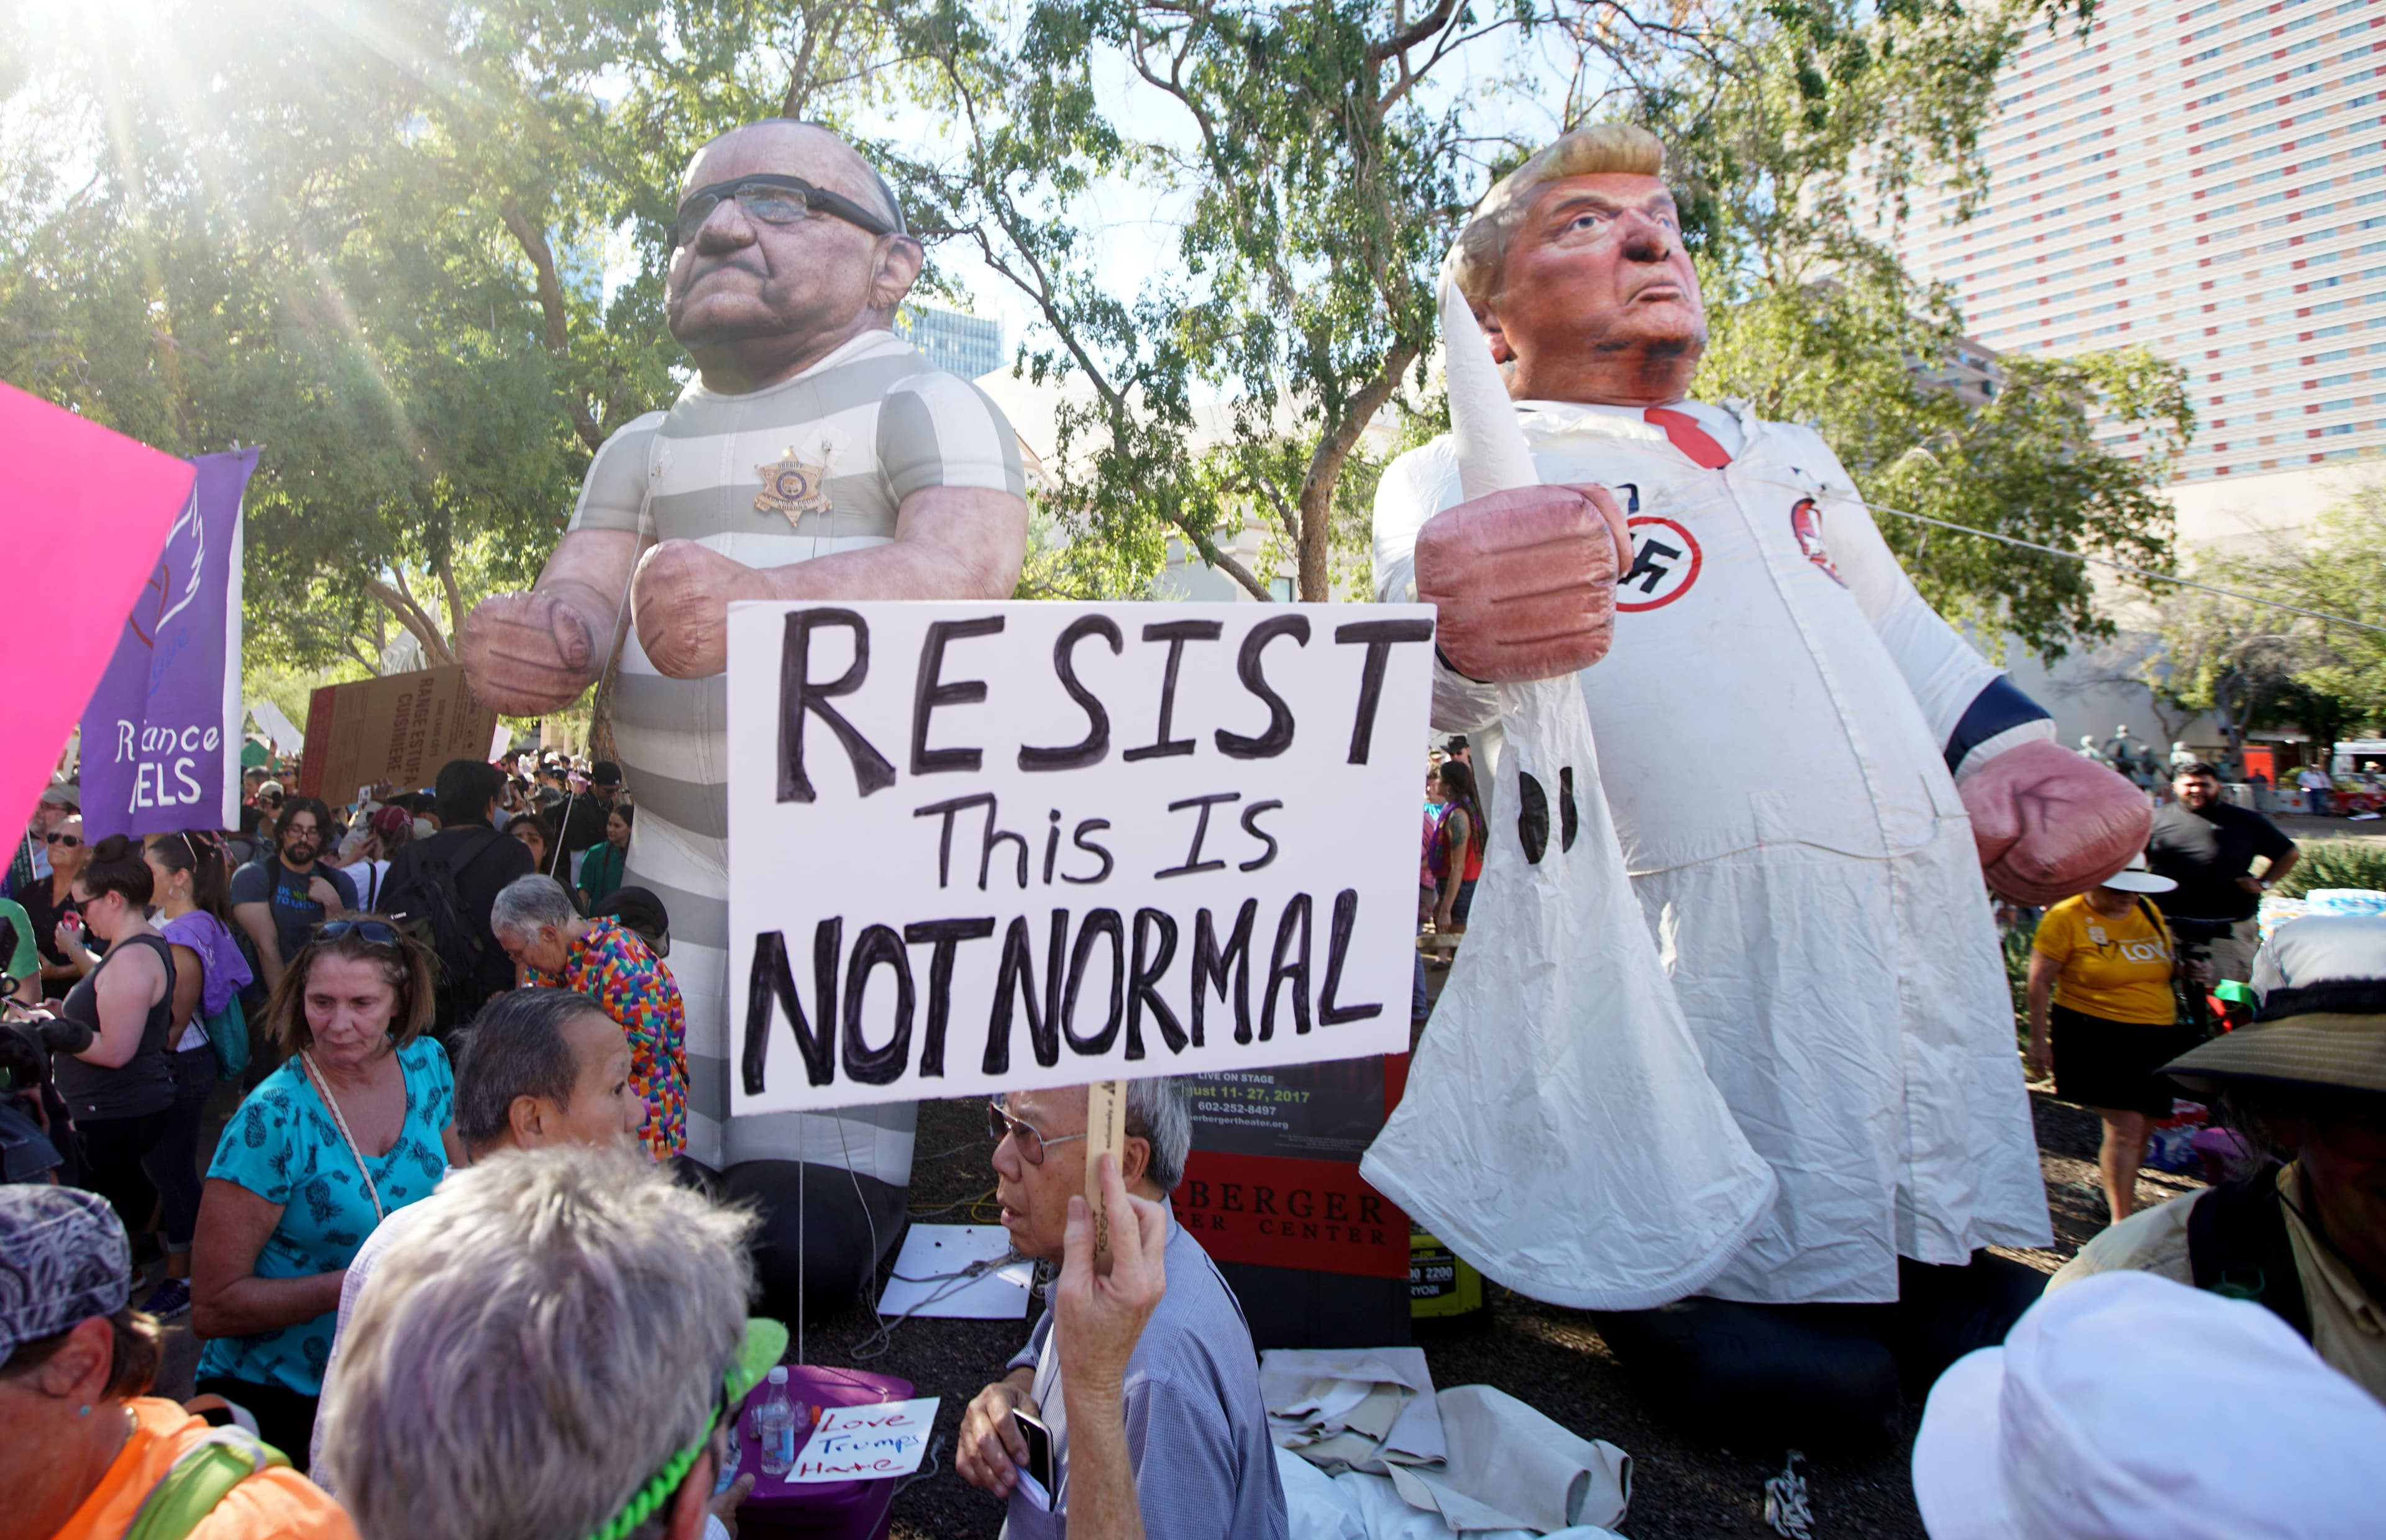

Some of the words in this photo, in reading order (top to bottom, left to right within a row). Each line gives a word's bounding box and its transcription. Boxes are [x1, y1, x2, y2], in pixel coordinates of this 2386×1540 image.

[413, 677, 434, 727] RANGE
[775, 607, 1434, 803] RESIST
[403, 731, 425, 786] ESTUFA
[913, 792, 1114, 890] This
[741, 916, 995, 1096] NOT
[982, 888, 1383, 1075] NORMAL
[1198, 1072, 1221, 1081] LIVE
[1223, 1073, 1239, 1082] ON
[1241, 1073, 1274, 1084] STAGE
[1185, 1087, 1217, 1097] ust
[1246, 1088, 1270, 1103] 27,
[1274, 1089, 1310, 1103] 2017
[1198, 1101, 1277, 1116] 602-252-8497
[1169, 1179, 1387, 1226] BERGER
[1259, 1219, 1386, 1246] CENTER
[1425, 1266, 1453, 1280] 2200
[820, 1413, 915, 1433] Love
[818, 1434, 920, 1454] Trumps
[798, 1459, 905, 1478] Hate
